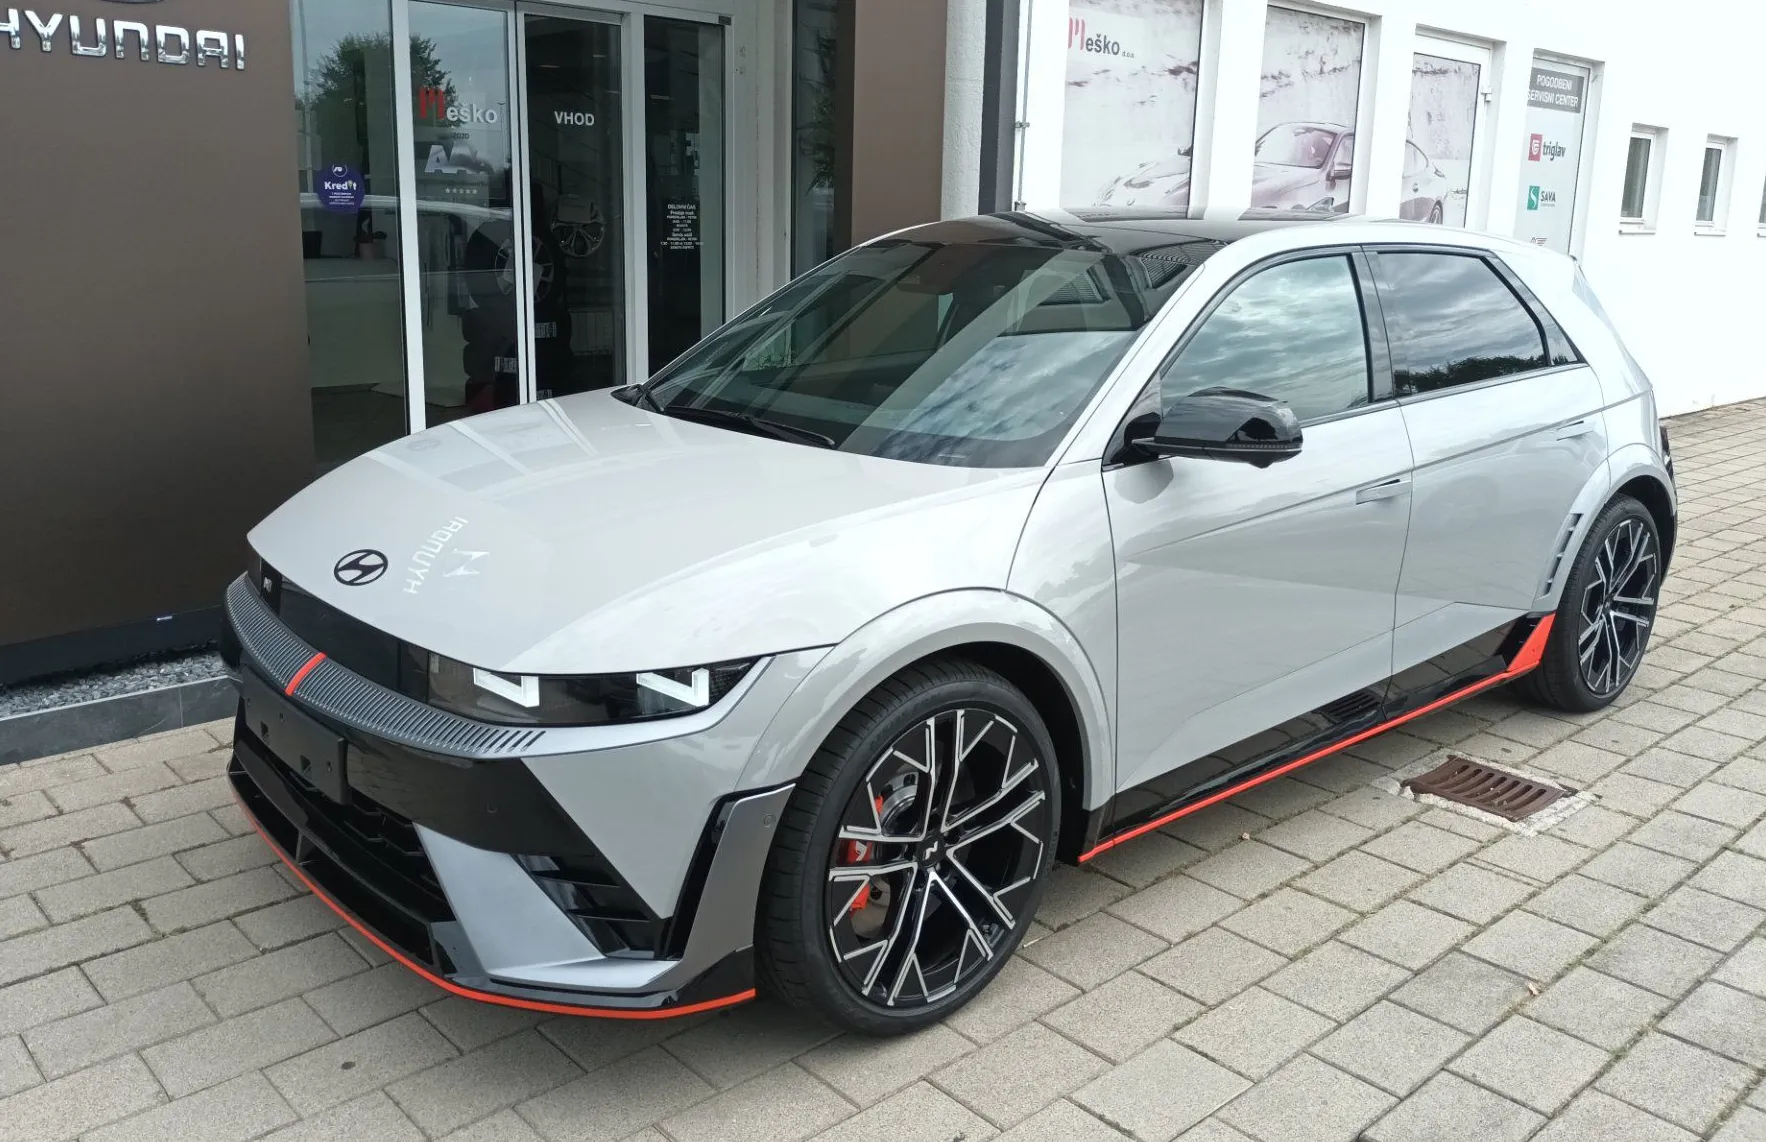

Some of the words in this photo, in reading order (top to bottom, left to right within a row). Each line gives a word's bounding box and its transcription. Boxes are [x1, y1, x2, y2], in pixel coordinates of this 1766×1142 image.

[1536, 75, 1573, 91] POGODBENI
[418, 87, 498, 124] Meško
[1555, 94, 1579, 108] CENTER
[554, 111, 595, 126] VHOD
[1543, 141, 1567, 161] triglav
[1541, 190, 1556, 202] SAVA
